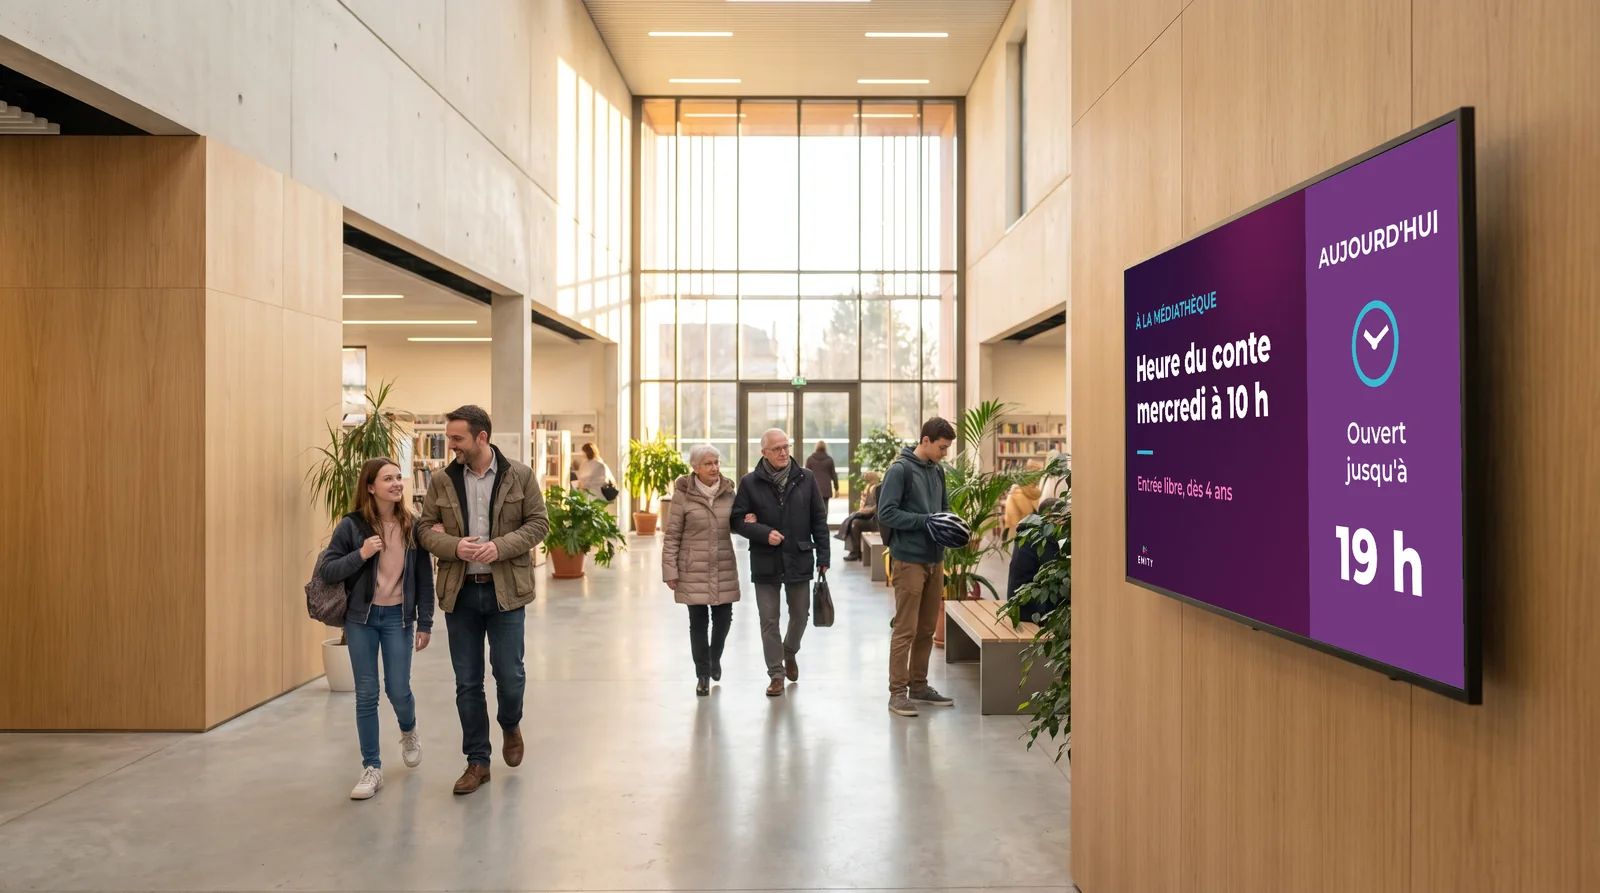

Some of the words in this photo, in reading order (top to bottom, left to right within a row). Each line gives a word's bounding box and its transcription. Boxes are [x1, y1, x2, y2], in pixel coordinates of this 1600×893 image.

[1319, 209, 1438, 269] AUJOURD'HUI
[1136, 312, 1142, 331] À
[1142, 311, 1153, 329] LA
[1153, 291, 1217, 325] MÉDIATHÈQUE
[1136, 354, 1180, 383] Heure
[1184, 341, 1207, 375] du
[1212, 331, 1271, 370] conte
[1137, 385, 1206, 424] mercredi
[1211, 385, 1222, 420] à
[1227, 384, 1249, 419] 10
[1254, 381, 1269, 418] h
[1347, 421, 1407, 445] Ouvert
[1137, 475, 1162, 494] Entrée
[1163, 476, 1185, 499] libre,
[1186, 479, 1204, 498] dès
[1205, 481, 1213, 499] 4
[1214, 485, 1233, 501] ans
[1345, 455, 1407, 488] jusqu'à
[1335, 525, 1378, 586] 19
[1393, 529, 1423, 597] h
